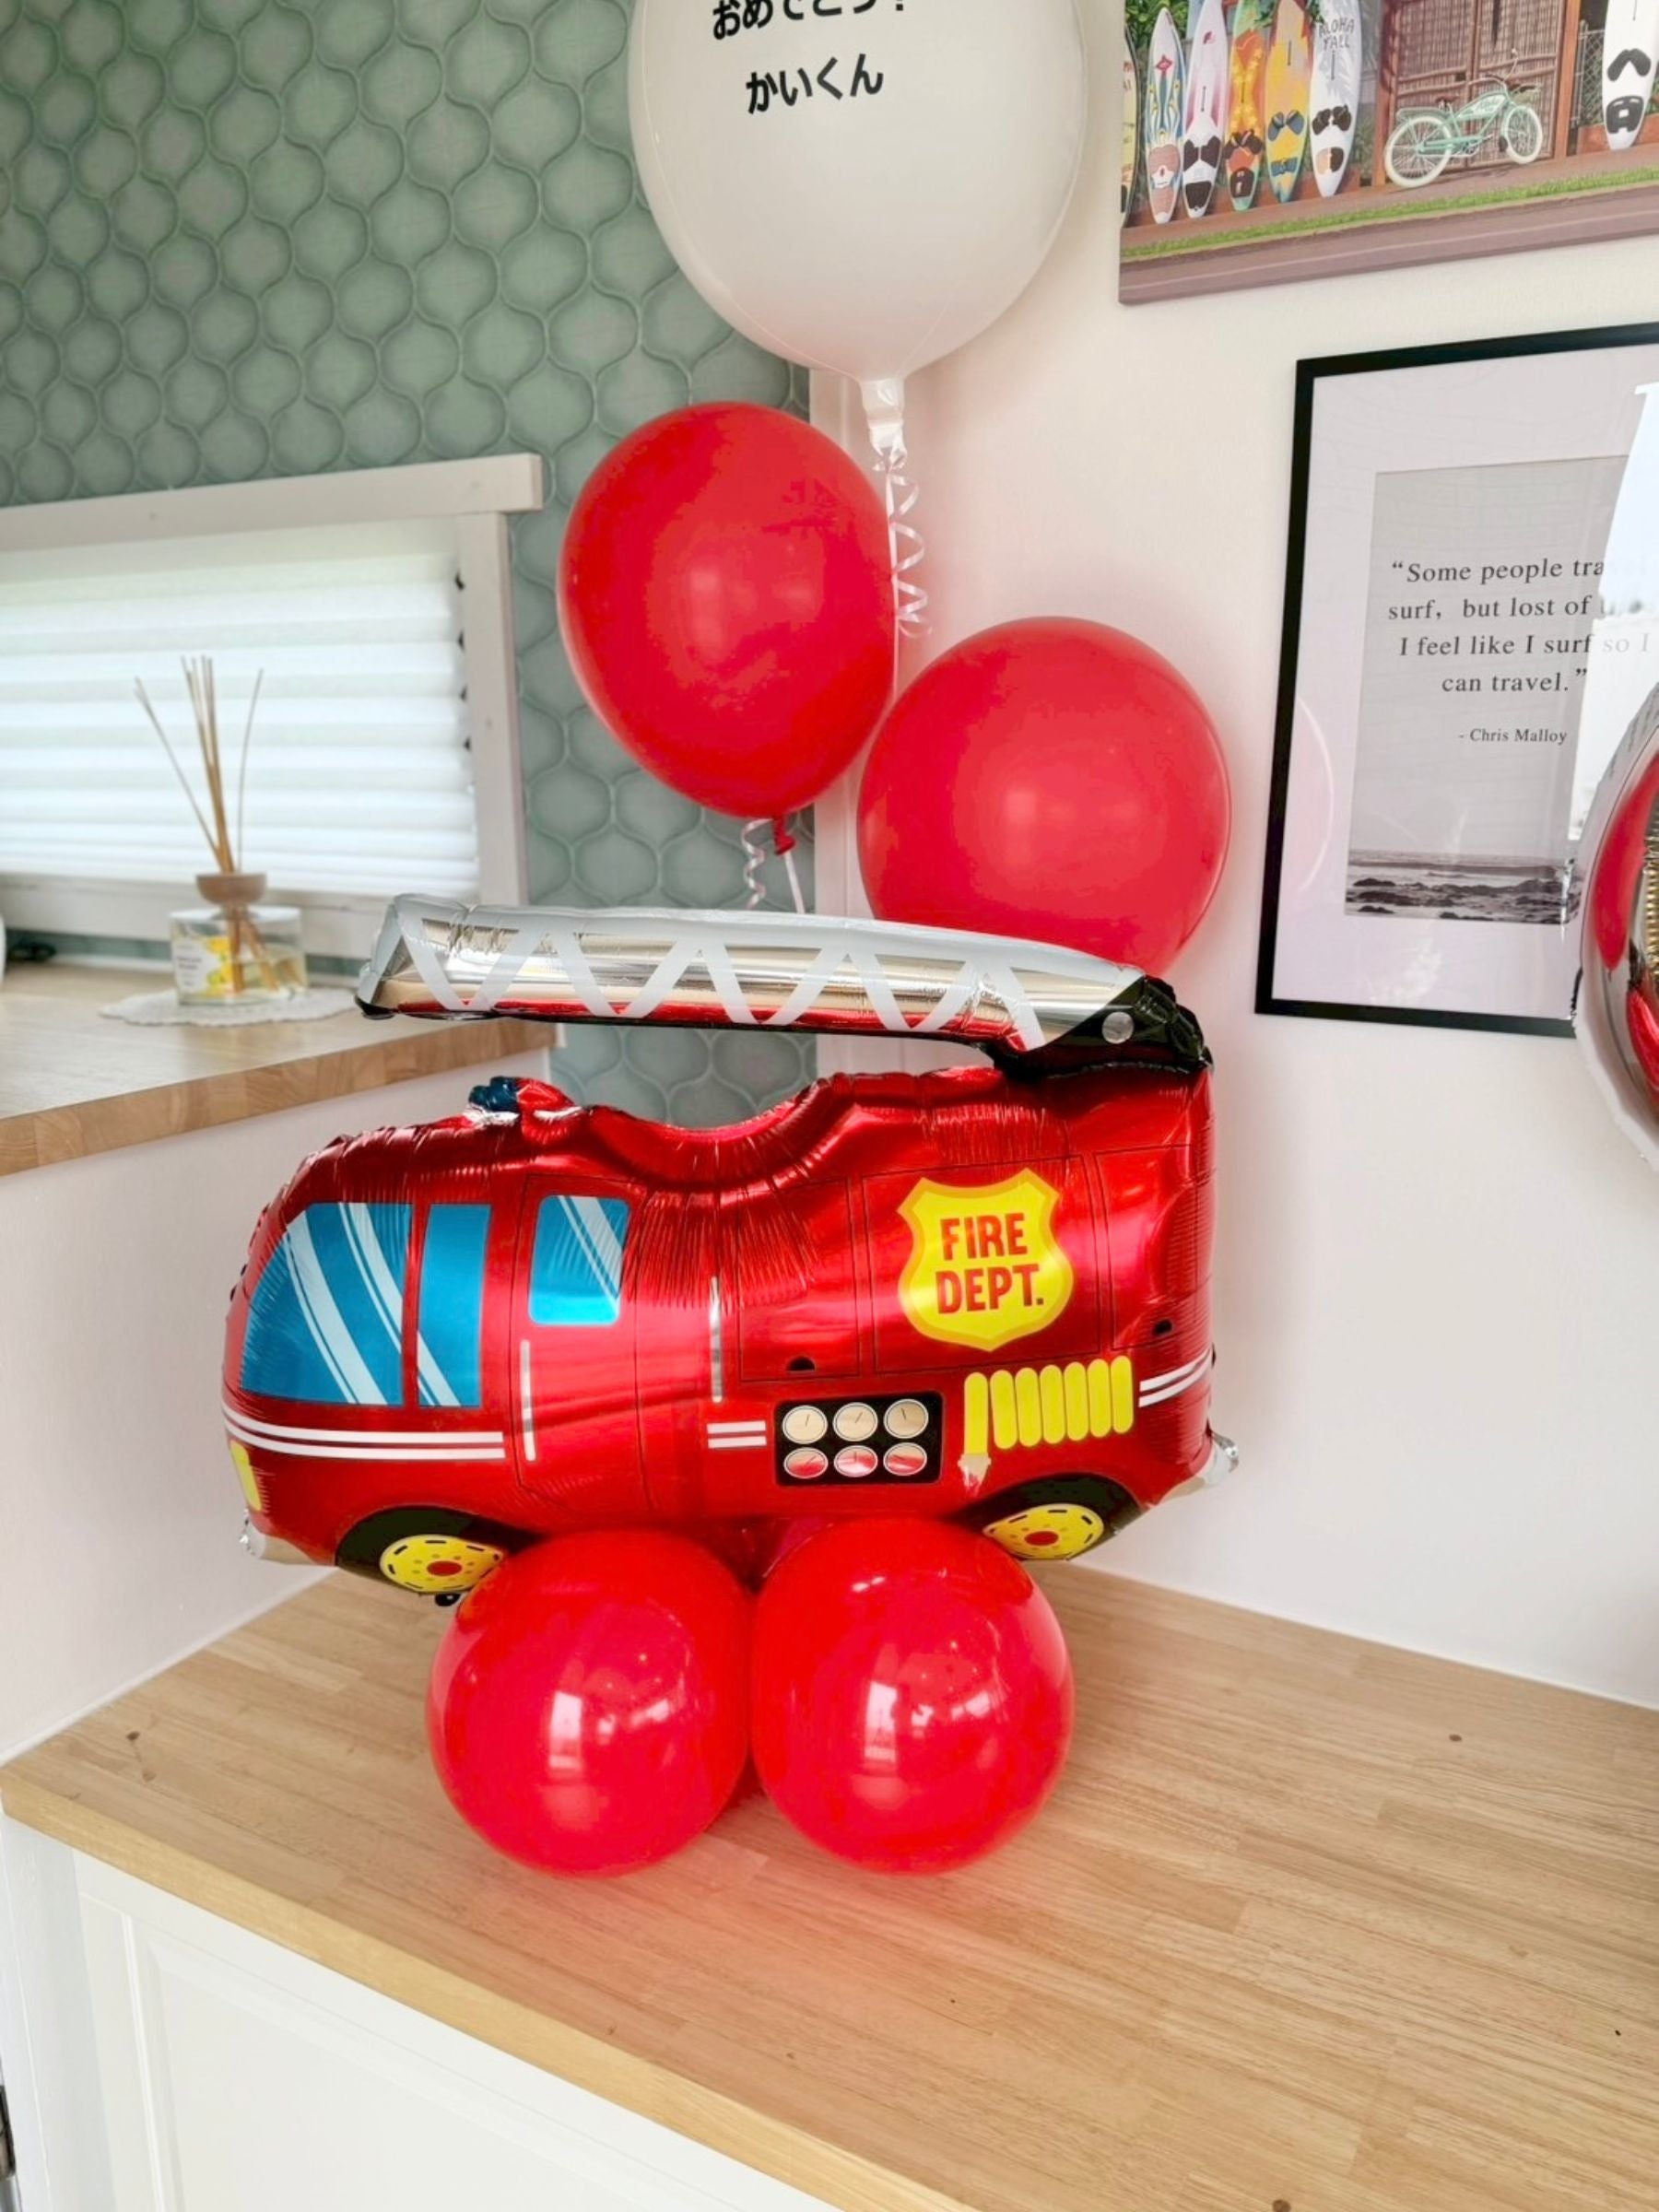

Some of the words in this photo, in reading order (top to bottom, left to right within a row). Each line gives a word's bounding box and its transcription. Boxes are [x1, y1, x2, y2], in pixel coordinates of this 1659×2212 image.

[747, 53, 883, 114] かいくん
[1480, 558, 1563, 586] people
[1573, 560, 1604, 577] tra
[1388, 599, 1441, 620] surf,
[1463, 598, 1500, 618] but
[1510, 596, 1555, 618] lost
[1564, 594, 1593, 616] of
[1399, 637, 1408, 656] I
[1418, 636, 1460, 656] feel
[1470, 635, 1515, 655] like
[1524, 634, 1535, 654] I
[1544, 634, 1593, 654] surf
[1603, 638, 1630, 653] so
[1441, 678, 1481, 693] can
[1469, 728, 1509, 742] Chris
[1515, 728, 1568, 746] Malloy
[940, 1213, 1028, 1260] FIRE
[935, 1264, 1044, 1314] DEPT.
